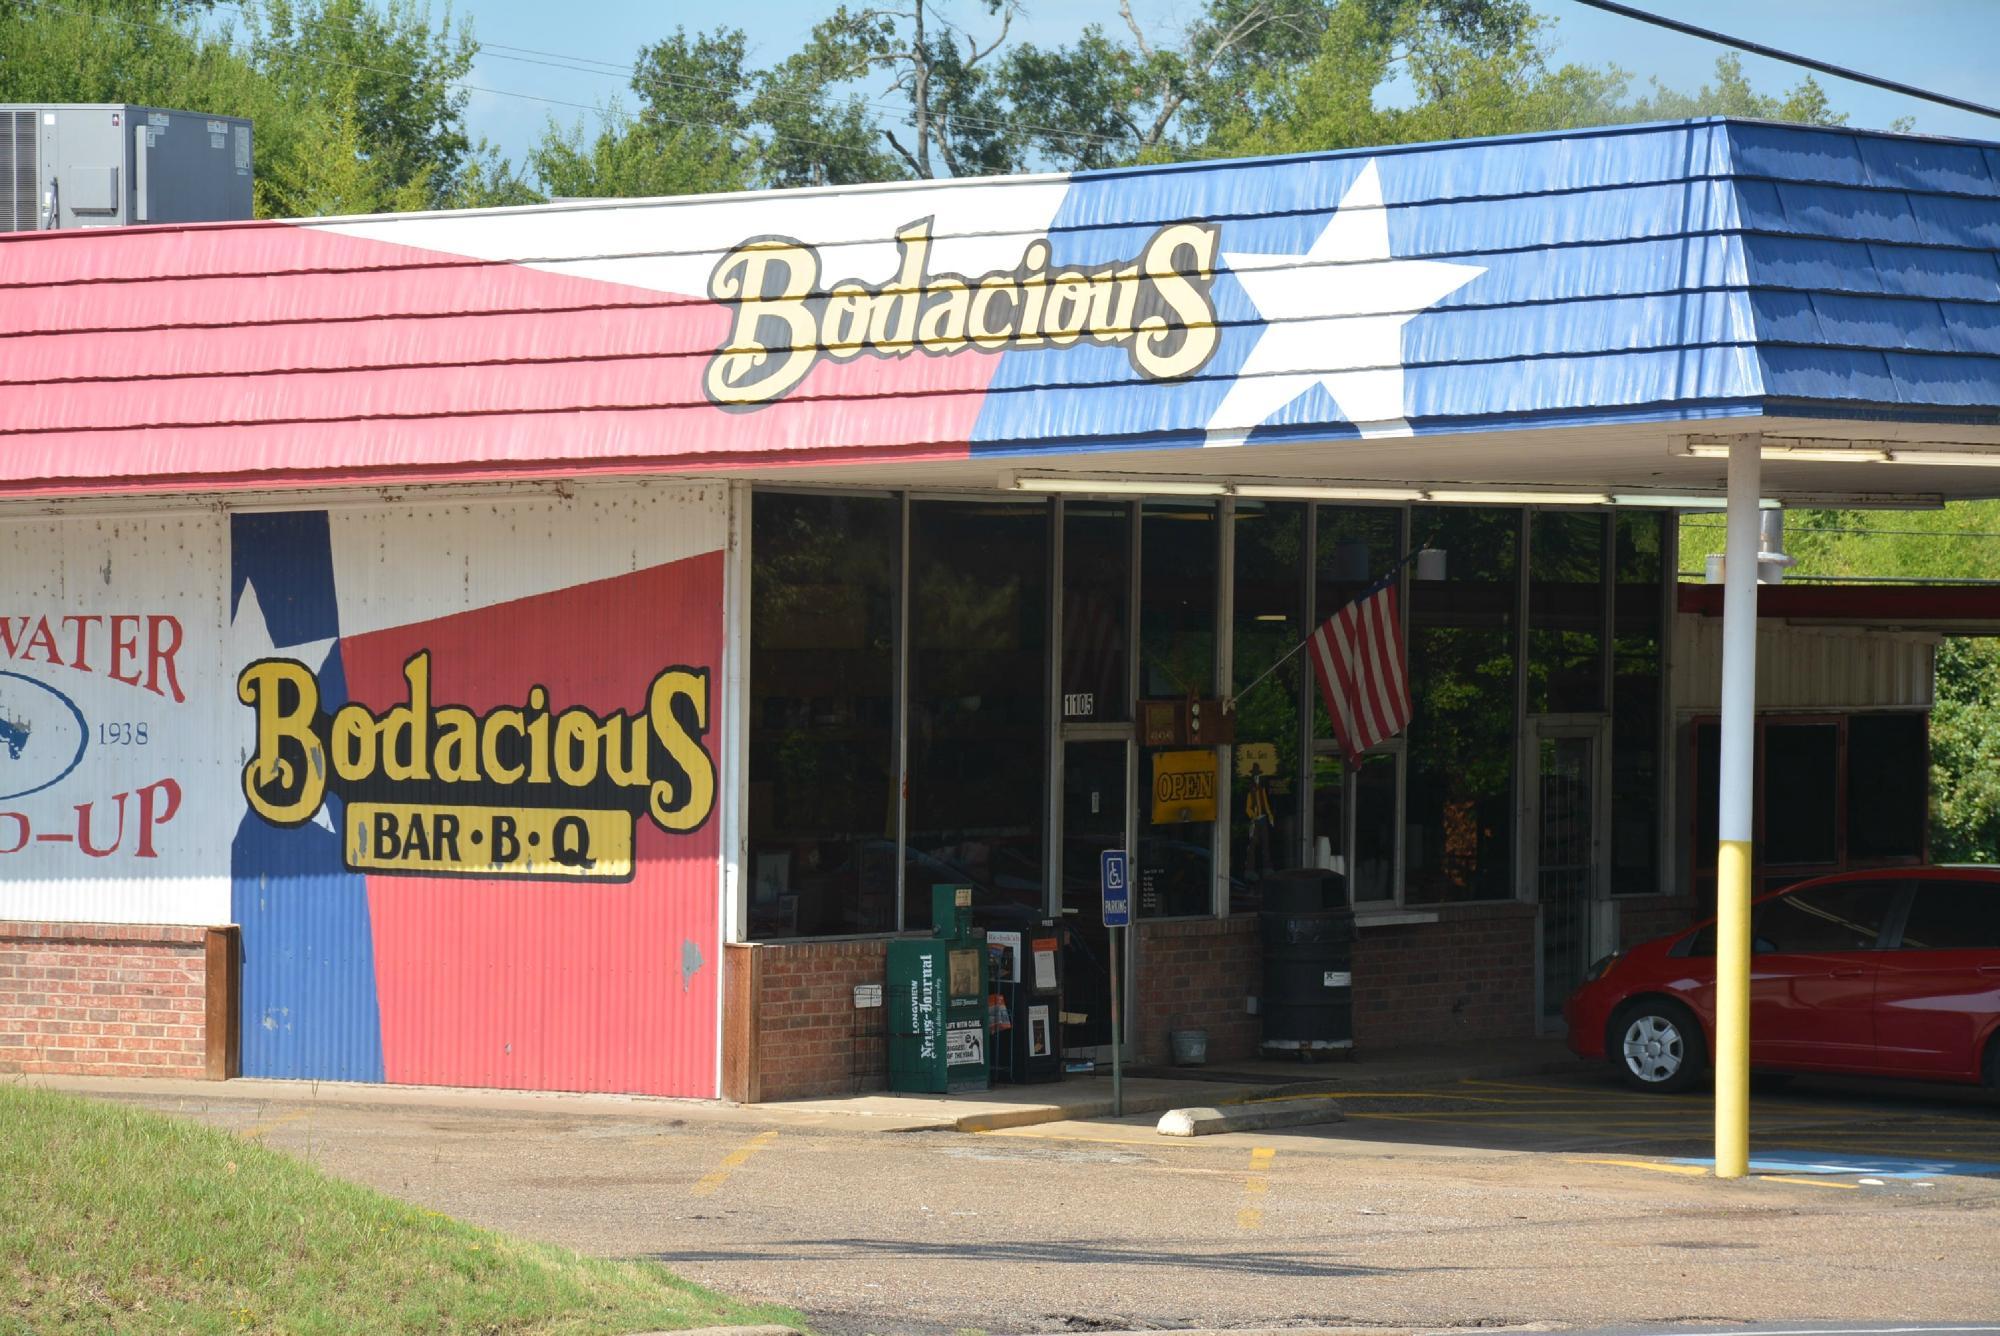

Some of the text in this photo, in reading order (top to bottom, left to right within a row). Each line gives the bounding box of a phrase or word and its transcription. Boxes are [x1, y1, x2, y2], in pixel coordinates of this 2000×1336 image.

[703, 215, 1222, 413] Bodacious
[1065, 694, 1093, 714] 1105
[98, 721, 149, 746] 1938
[237, 648, 717, 834] Bodacious
[1157, 772, 1214, 802] OPEN
[1104, 899, 1127, 914] PARKING
[911, 979, 919, 1034] LONGVIEW
